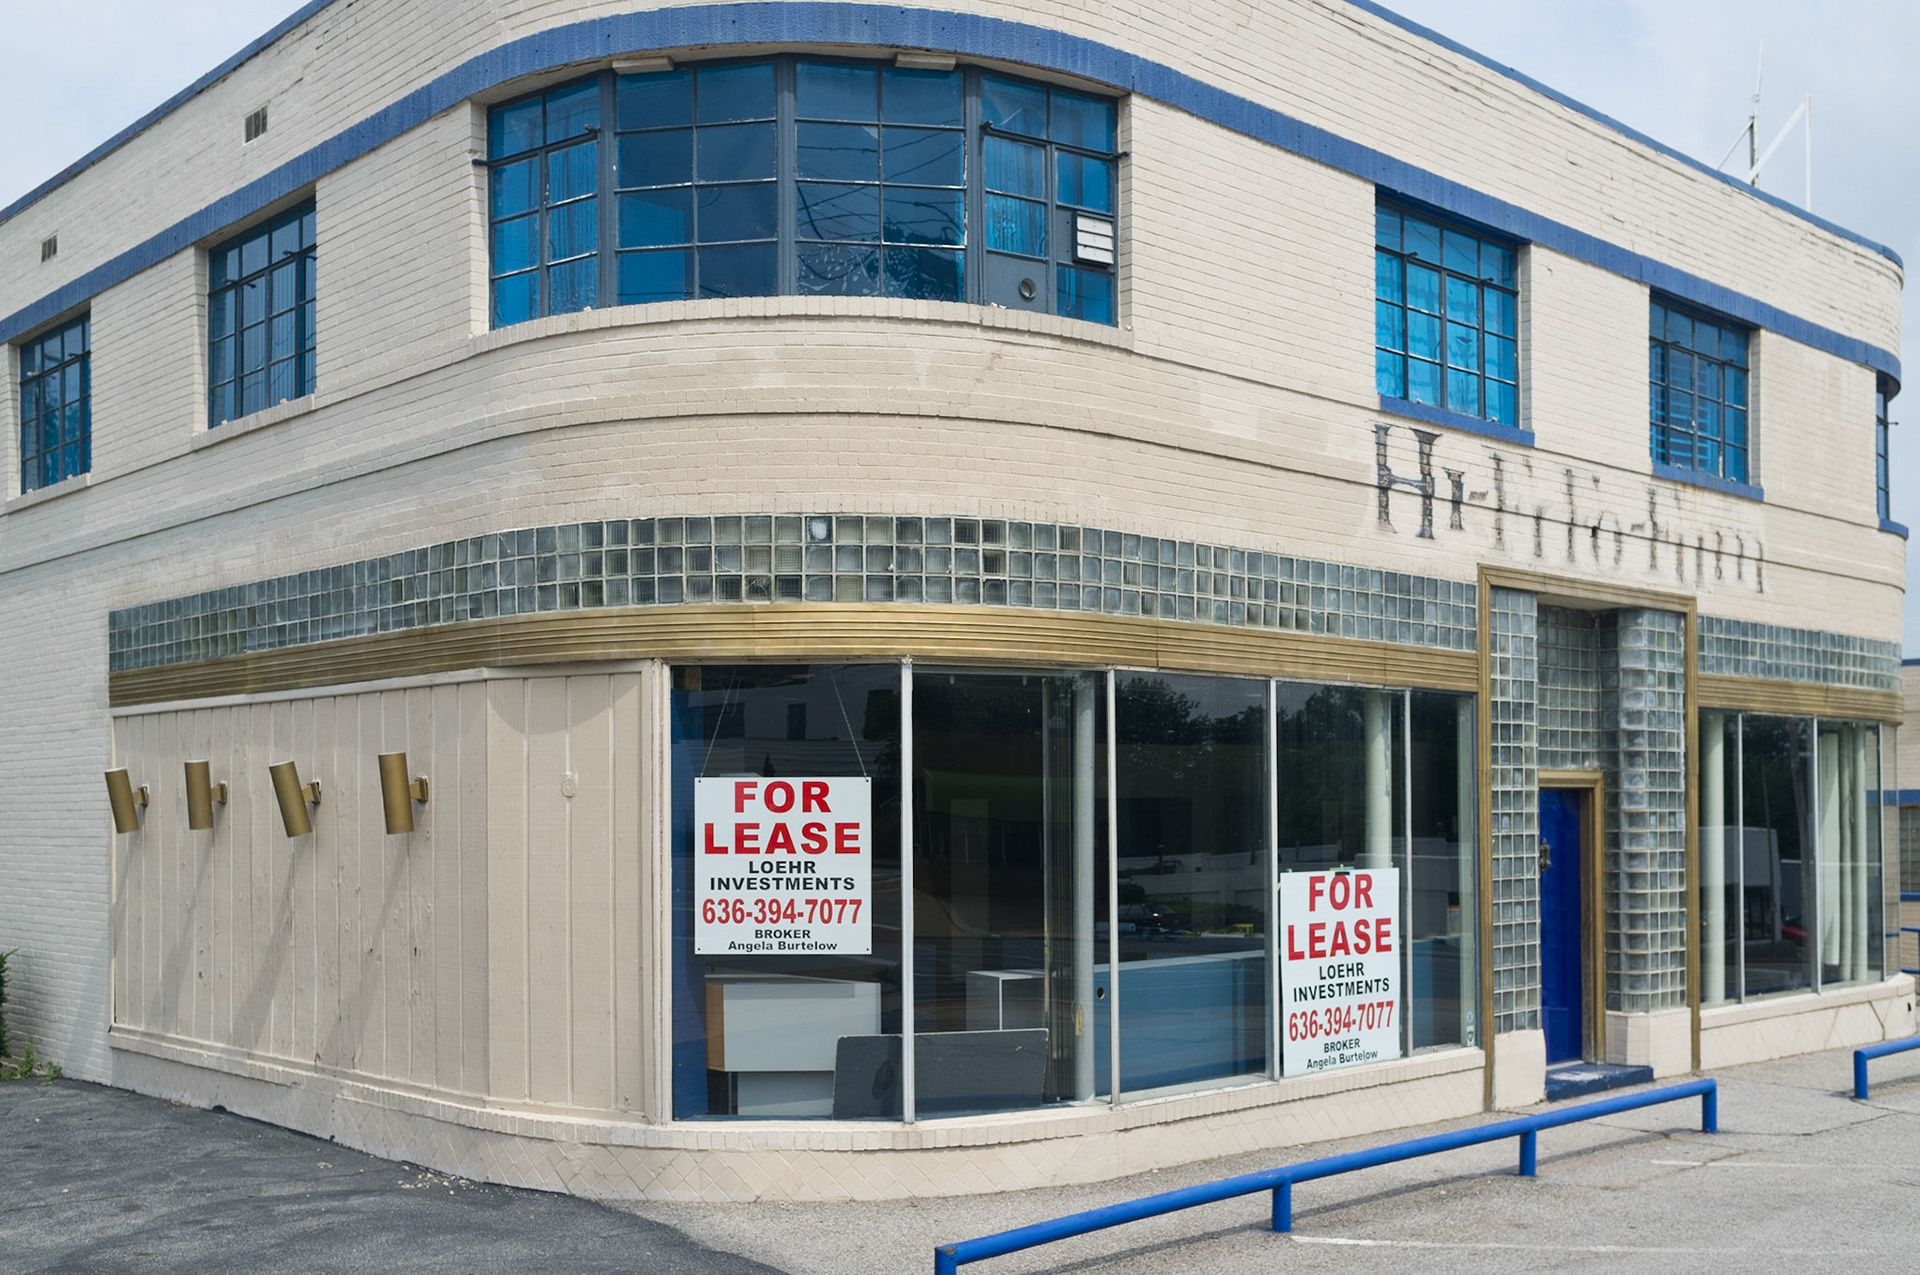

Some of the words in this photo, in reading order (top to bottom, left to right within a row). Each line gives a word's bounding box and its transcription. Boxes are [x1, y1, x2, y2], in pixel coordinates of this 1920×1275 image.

[735, 781, 831, 813] FOR
[704, 822, 860, 855] LEASE
[749, 861, 816, 874] LOEHR
[710, 877, 855, 891] INVESTMENTS
[1309, 874, 1373, 912] FOR
[702, 898, 862, 924] 636-394-7077
[755, 929, 811, 939] BROKER
[1288, 918, 1392, 961] LEASE
[728, 941, 773, 952] Angela
[778, 941, 838, 951] Burtelow
[1319, 962, 1364, 980] LOEHR
[1294, 978, 1389, 1002] INVESTMENTS
[1289, 1000, 1394, 1041] 636-394-7077
[1324, 1038, 1360, 1053] BROKER
[1306, 1055, 1336, 1070] Angela
[1339, 1050, 1378, 1064] Burtelow
